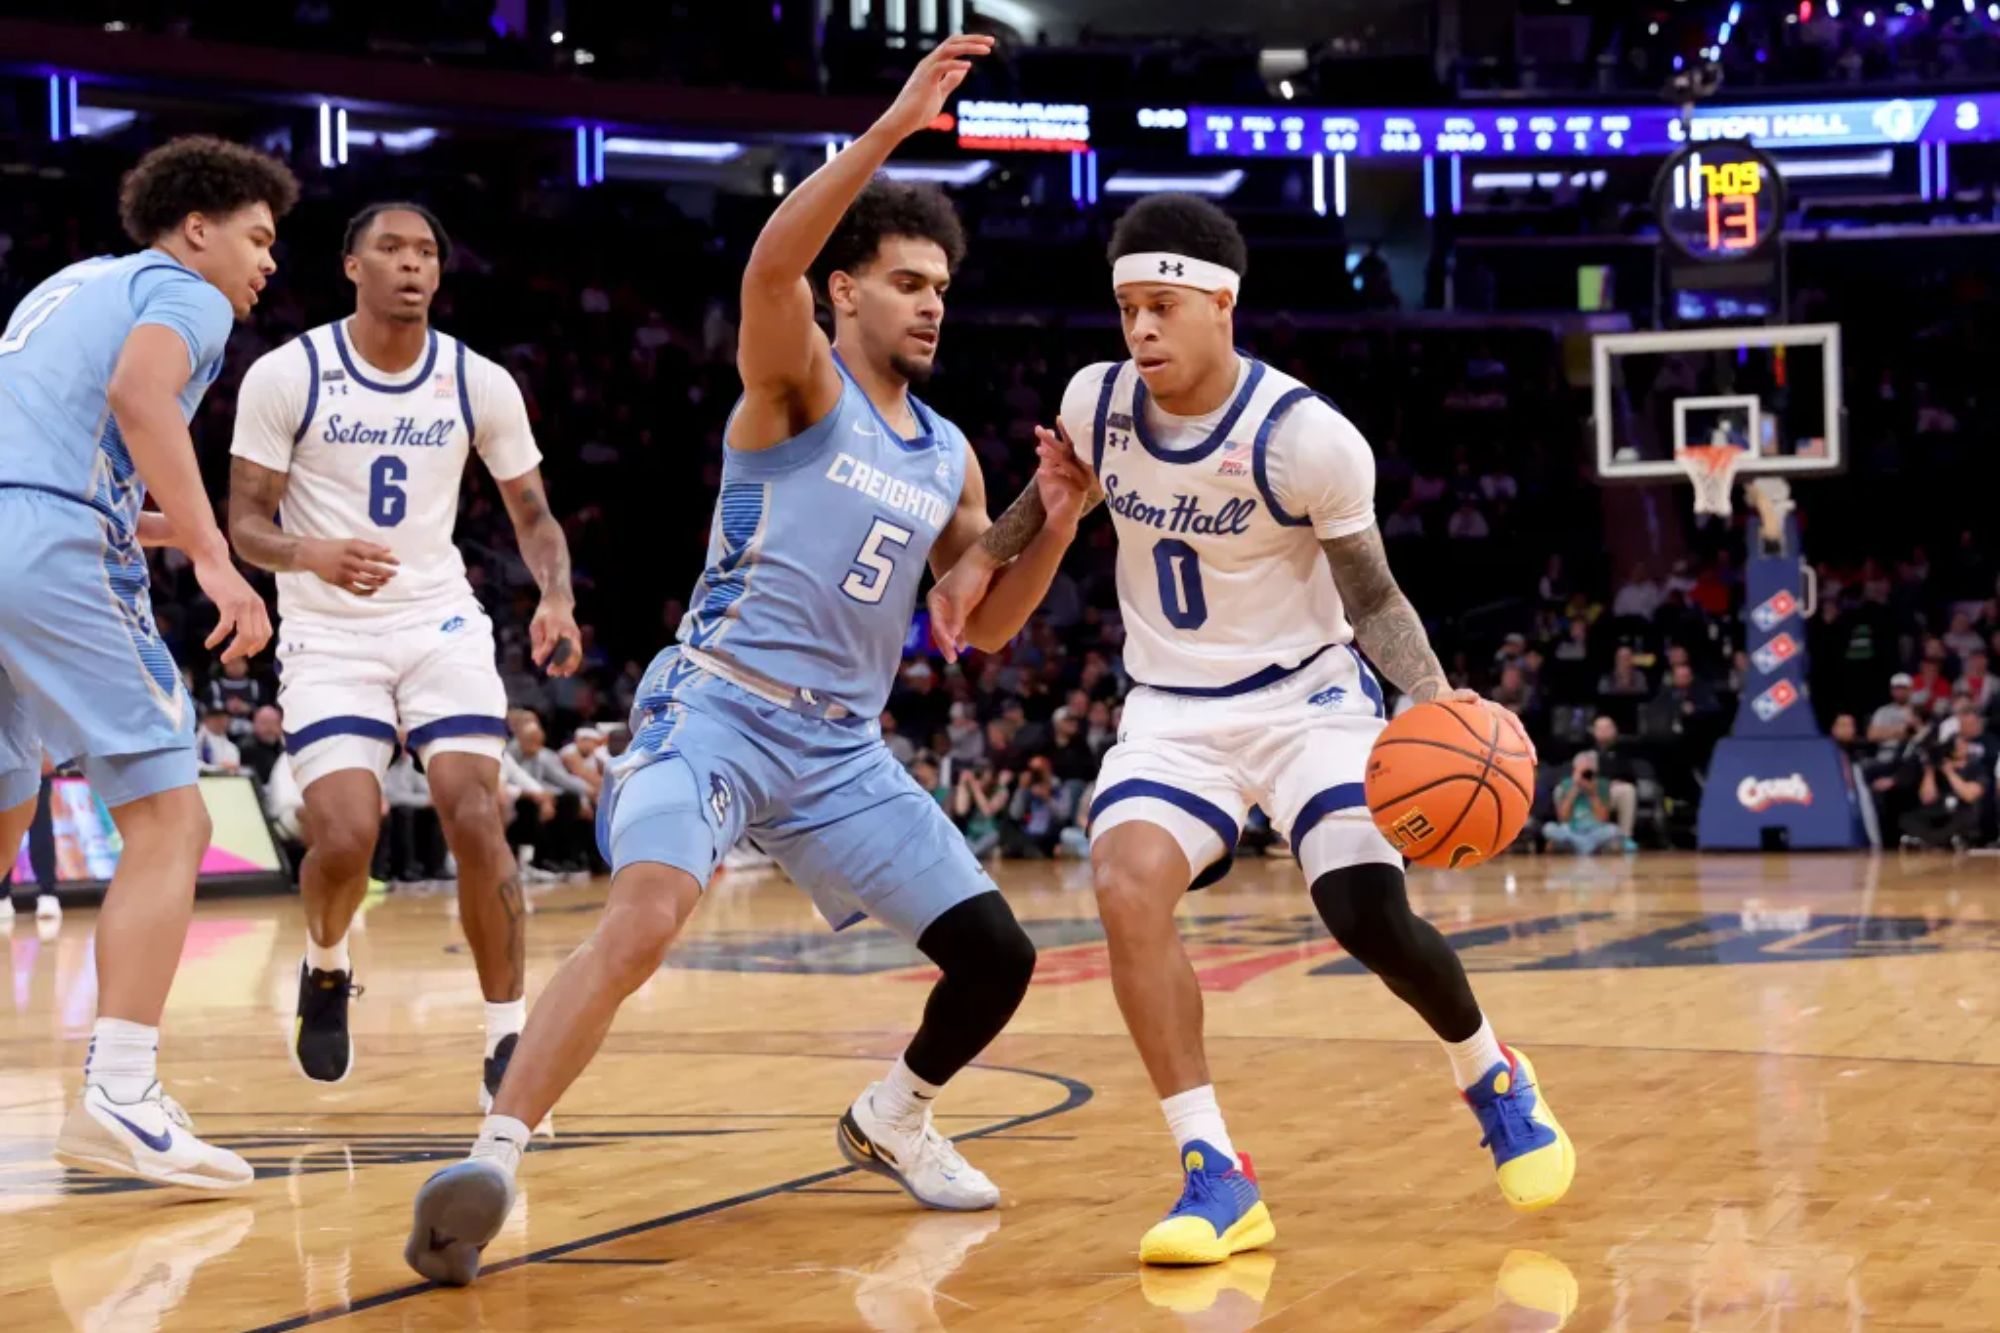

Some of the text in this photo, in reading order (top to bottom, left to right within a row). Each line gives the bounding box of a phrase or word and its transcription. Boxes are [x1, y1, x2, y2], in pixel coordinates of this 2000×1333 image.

[1772, 112, 1850, 137] HALL
[1707, 194, 1757, 250] 13
[323, 413, 456, 447] Seton Hall
[368, 454, 408, 528] 6
[826, 452, 951, 531] CREIGHTO
[1105, 473, 1257, 535] Seton Hall
[838, 514, 915, 606] 5
[1152, 537, 1208, 631] 0
